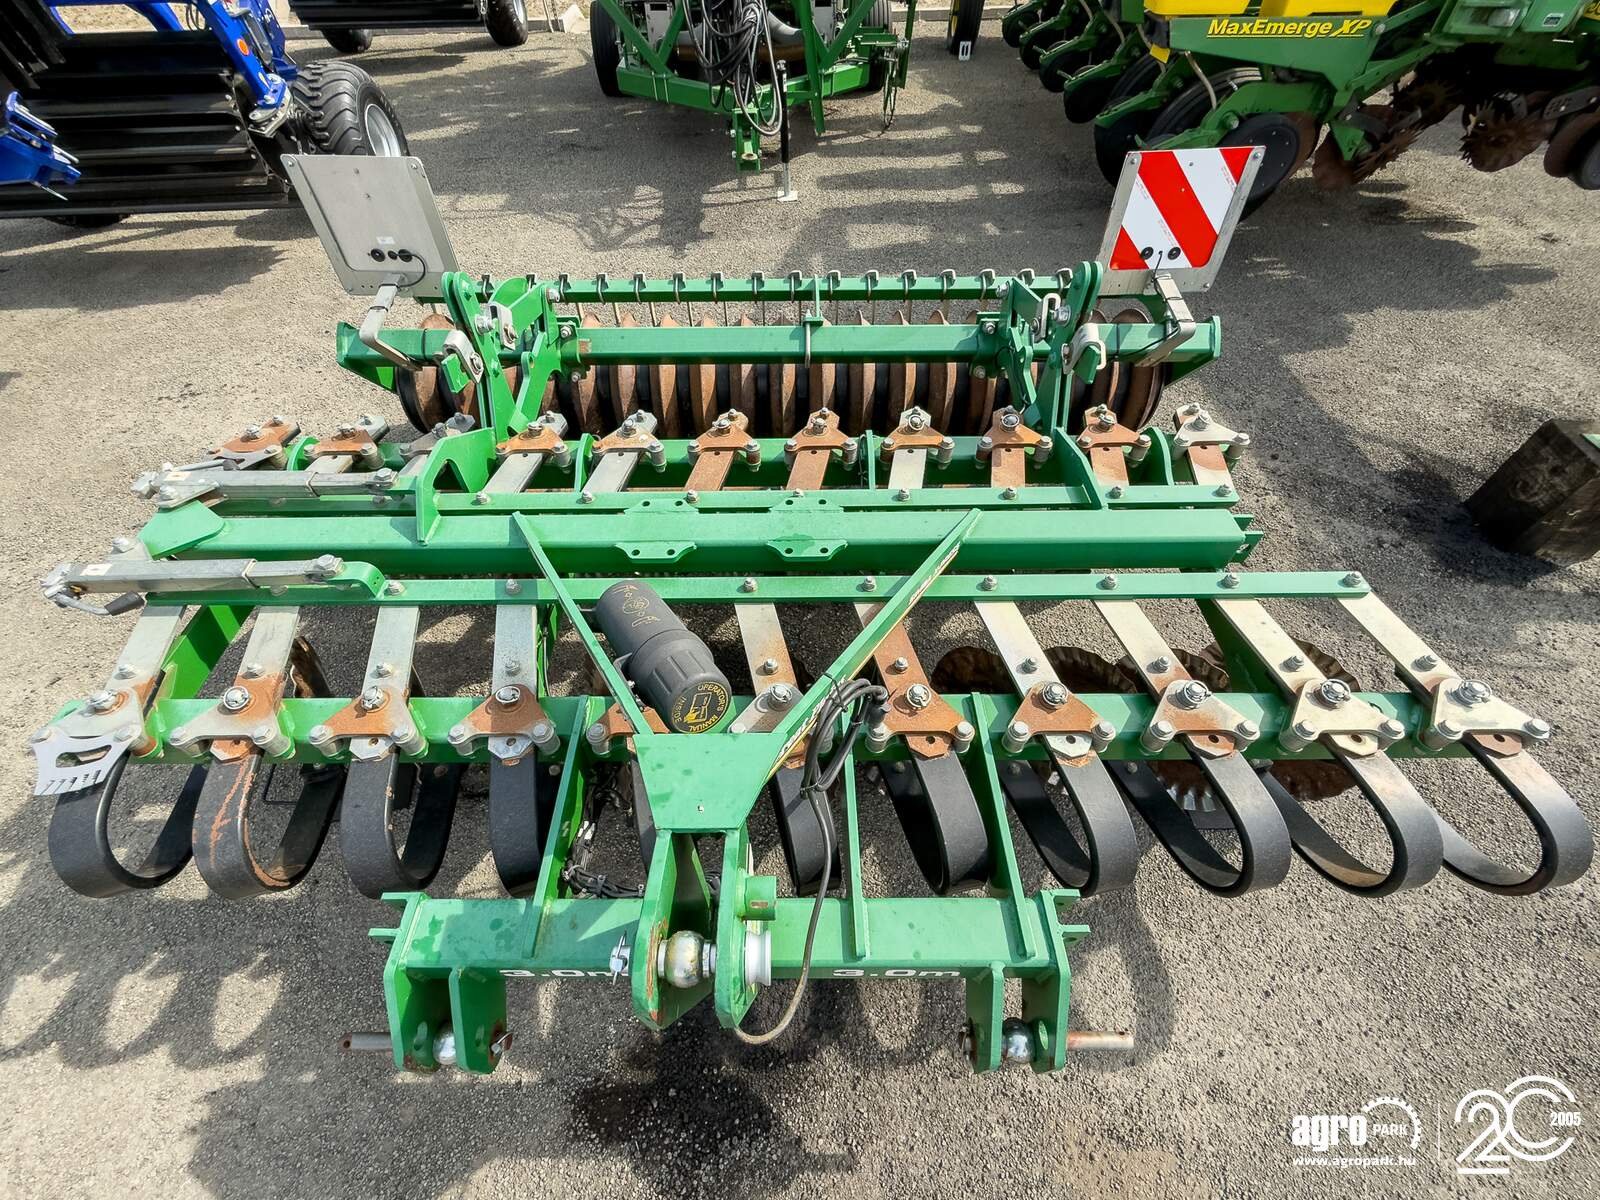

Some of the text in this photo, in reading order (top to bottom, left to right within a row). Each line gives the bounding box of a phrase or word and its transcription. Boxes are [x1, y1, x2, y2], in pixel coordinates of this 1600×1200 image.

[1207, 19, 1372, 38] MaxEmerge XP
[688, 714, 718, 732] MANUAL
[833, 969, 960, 977] 3.0m
